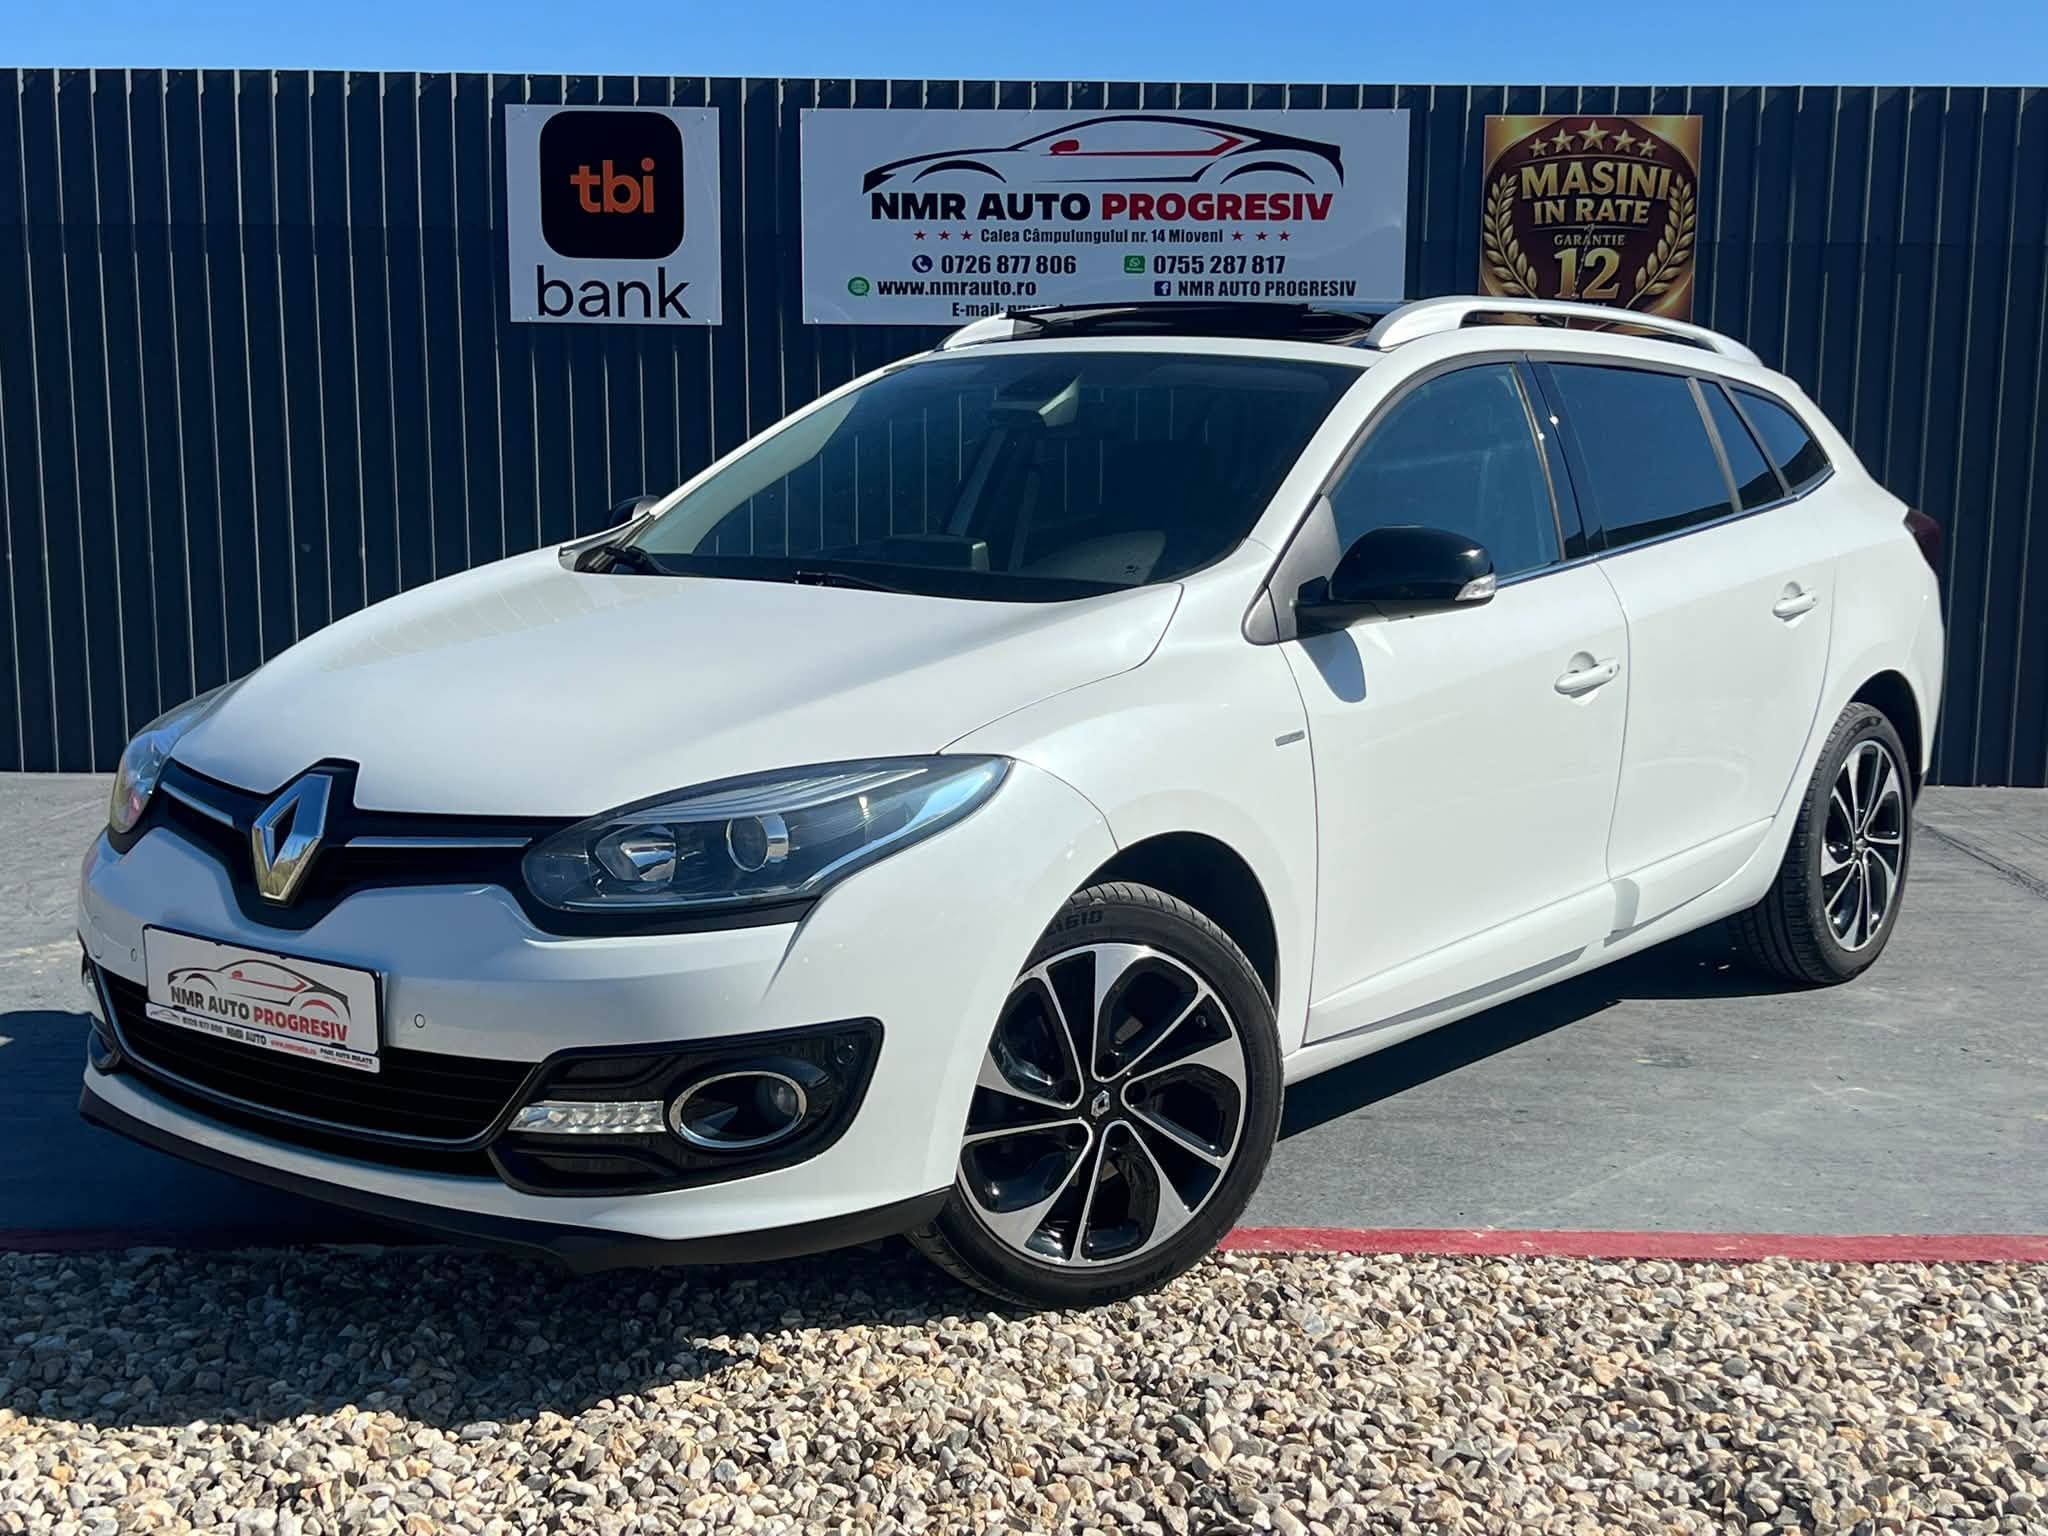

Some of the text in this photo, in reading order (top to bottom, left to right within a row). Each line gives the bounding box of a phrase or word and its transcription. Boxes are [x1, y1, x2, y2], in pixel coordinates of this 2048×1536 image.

[570, 157, 655, 214] tbi
[1520, 160, 1673, 201] MASINI
[871, 192, 1334, 222] NMR AUTO PROGRESIV
[1533, 198, 1651, 225] IN RATE
[980, 228, 1224, 245] Calea Câmpulungului nr. 14 Mioveni
[1553, 234, 1626, 247] GARANTIE
[941, 255, 1077, 275] 0726 877 806
[1153, 255, 1287, 275] 0755 287 817
[1553, 247, 1621, 300] 12
[536, 264, 691, 319] bank
[877, 279, 1038, 297] www.nmrauto.ro
[1178, 281, 1357, 297] NMR AUTO PROGRESIV
[170, 986, 348, 1042] NMR AUTO PROGRESIV
